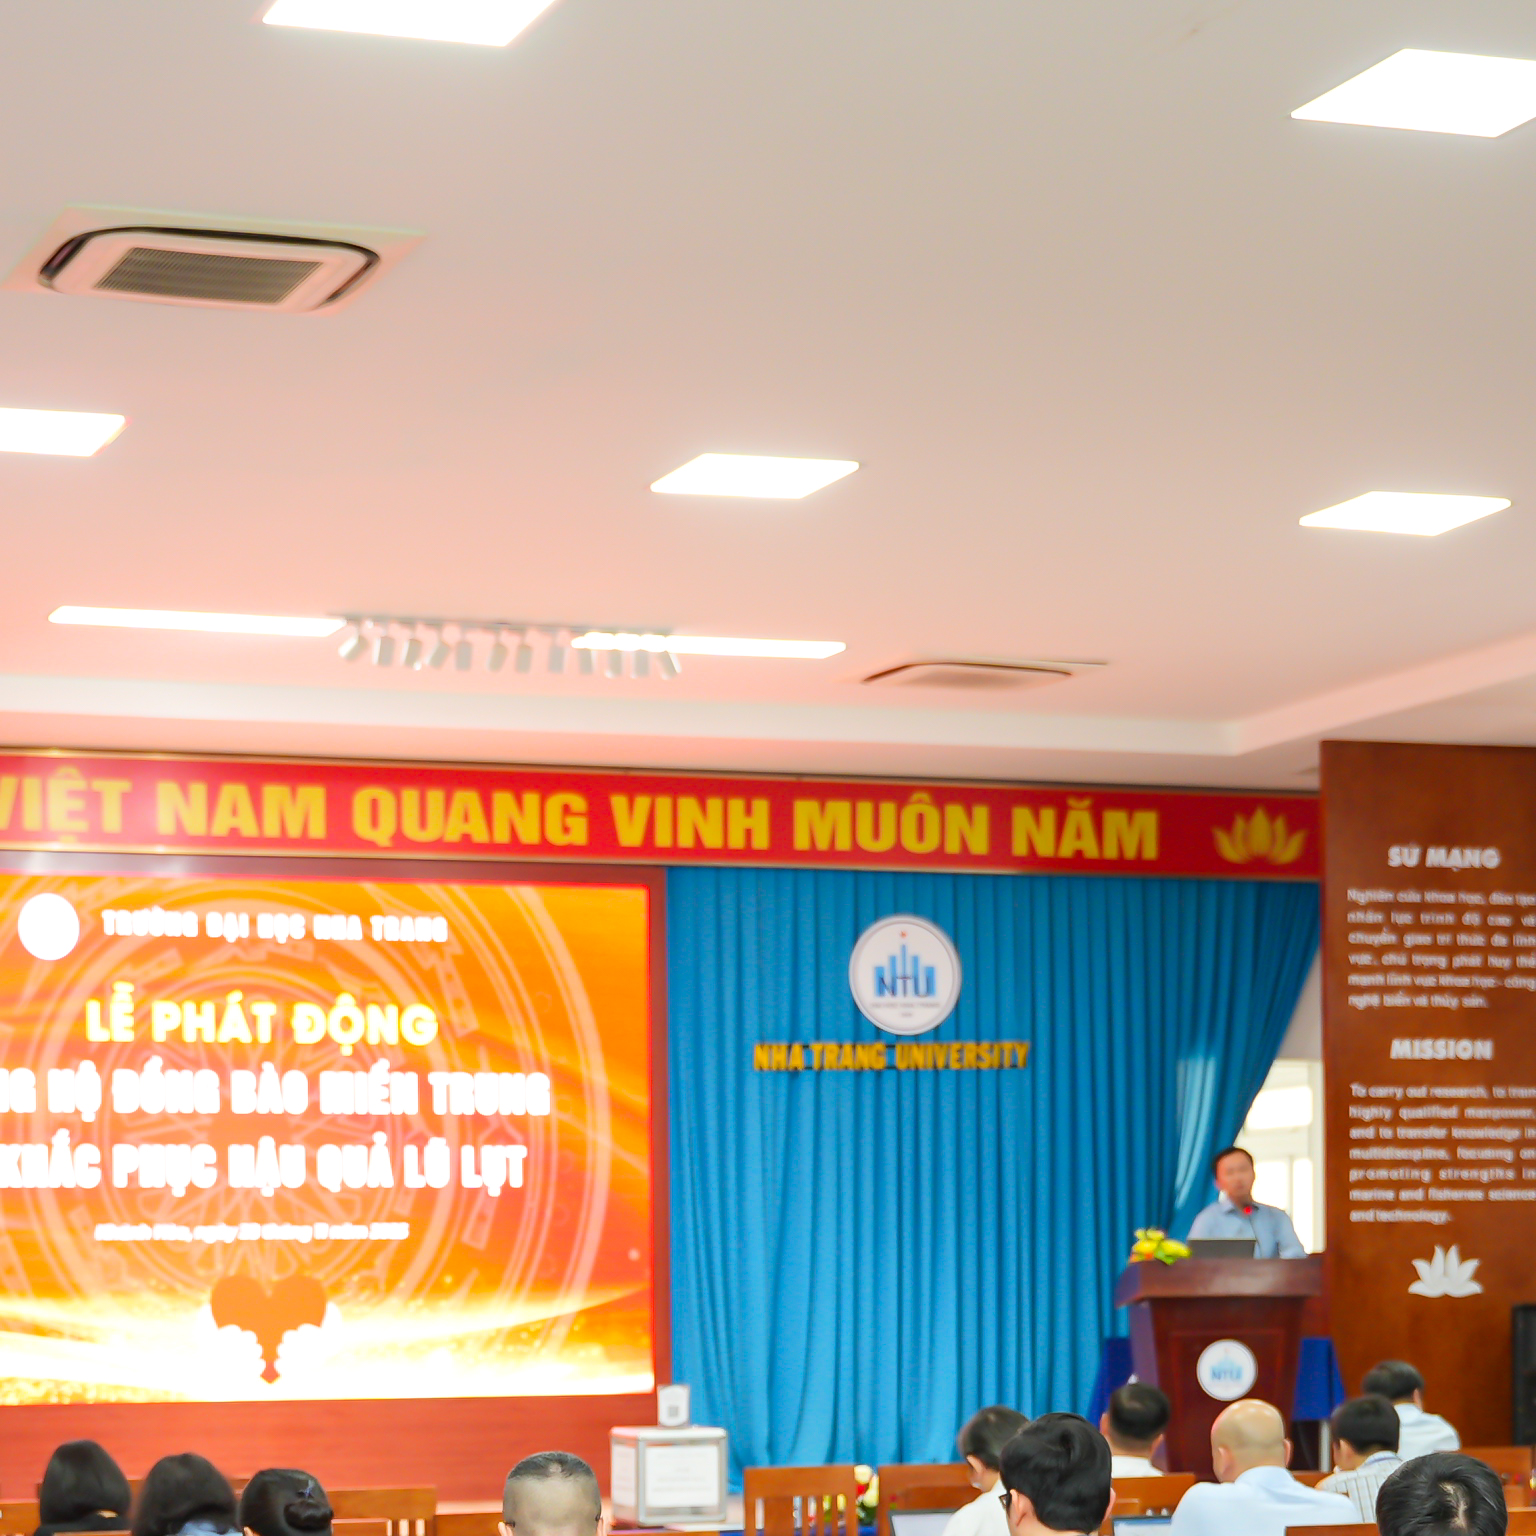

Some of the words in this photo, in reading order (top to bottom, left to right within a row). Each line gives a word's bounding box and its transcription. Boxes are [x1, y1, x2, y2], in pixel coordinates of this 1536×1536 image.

[156, 780, 327, 840] NAM
[353, 786, 588, 847] QUANG
[610, 795, 770, 851] VINH
[793, 793, 989, 855] MUÔN
[1012, 797, 1158, 861] NĂM
[1425, 847, 1502, 872] MẠNG
[874, 968, 935, 998] NTU
[86, 982, 135, 1042] LỄ
[152, 990, 276, 1044] PHÁT
[292, 992, 439, 1057] ĐỘNG
[754, 1043, 804, 1070] NHA
[810, 1043, 886, 1070] TRANG
[895, 1042, 1029, 1070] UNIVERSITY
[1390, 1038, 1494, 1061] MISSION
